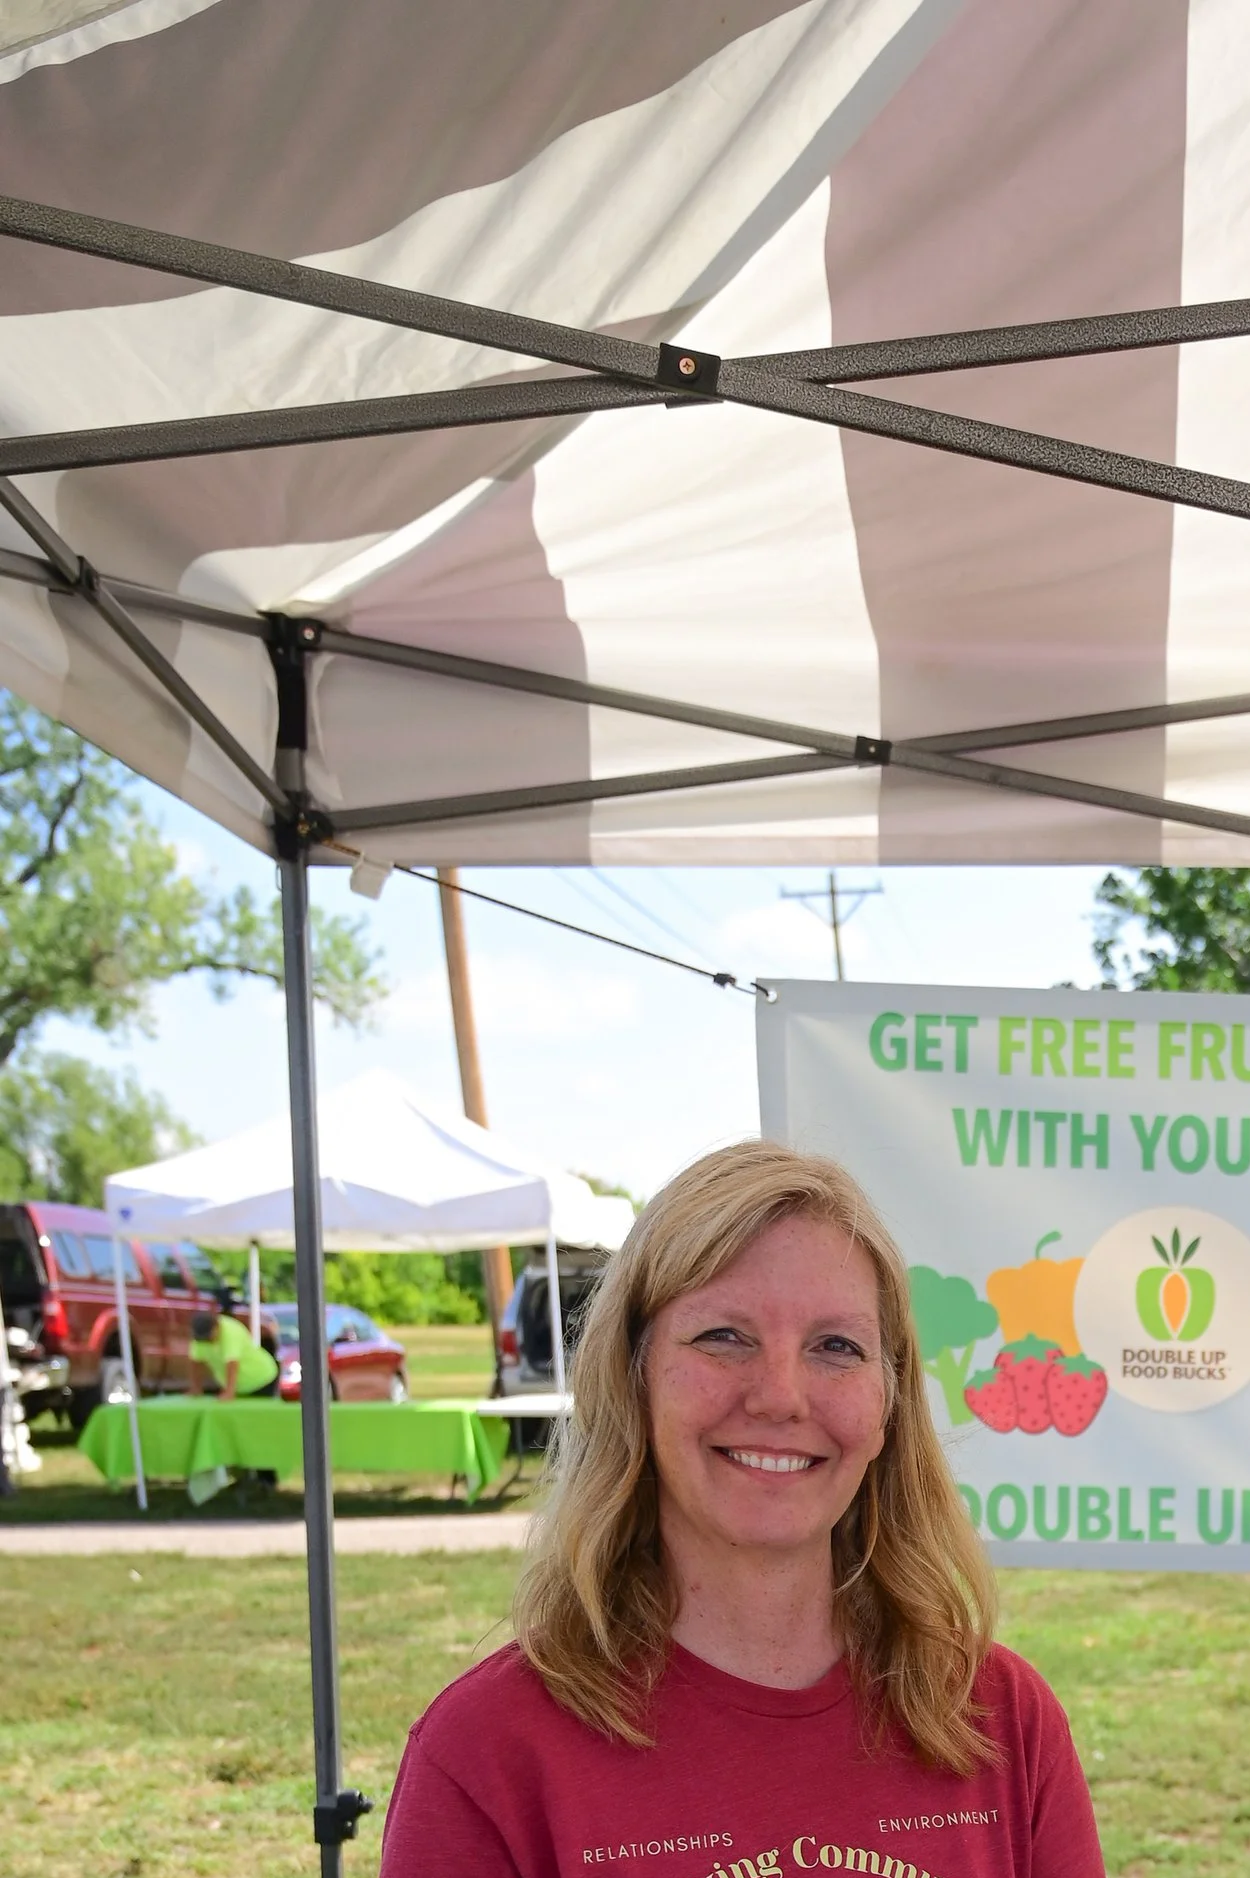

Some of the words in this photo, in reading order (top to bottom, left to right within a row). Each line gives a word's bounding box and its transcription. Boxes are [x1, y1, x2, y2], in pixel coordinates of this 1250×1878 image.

[868, 1012, 979, 1074] GET
[999, 1016, 1136, 1079] FREE
[952, 1108, 1110, 1169] WITH
[1123, 1349, 1196, 1364] DOUBLE
[1201, 1351, 1227, 1365] UP
[1123, 1365, 1168, 1379] FOOD
[1172, 1366, 1227, 1381] BUCKS
[879, 1810, 999, 1834] ENVIRONMENT
[583, 1833, 734, 1864] RELATIONSHIPS
